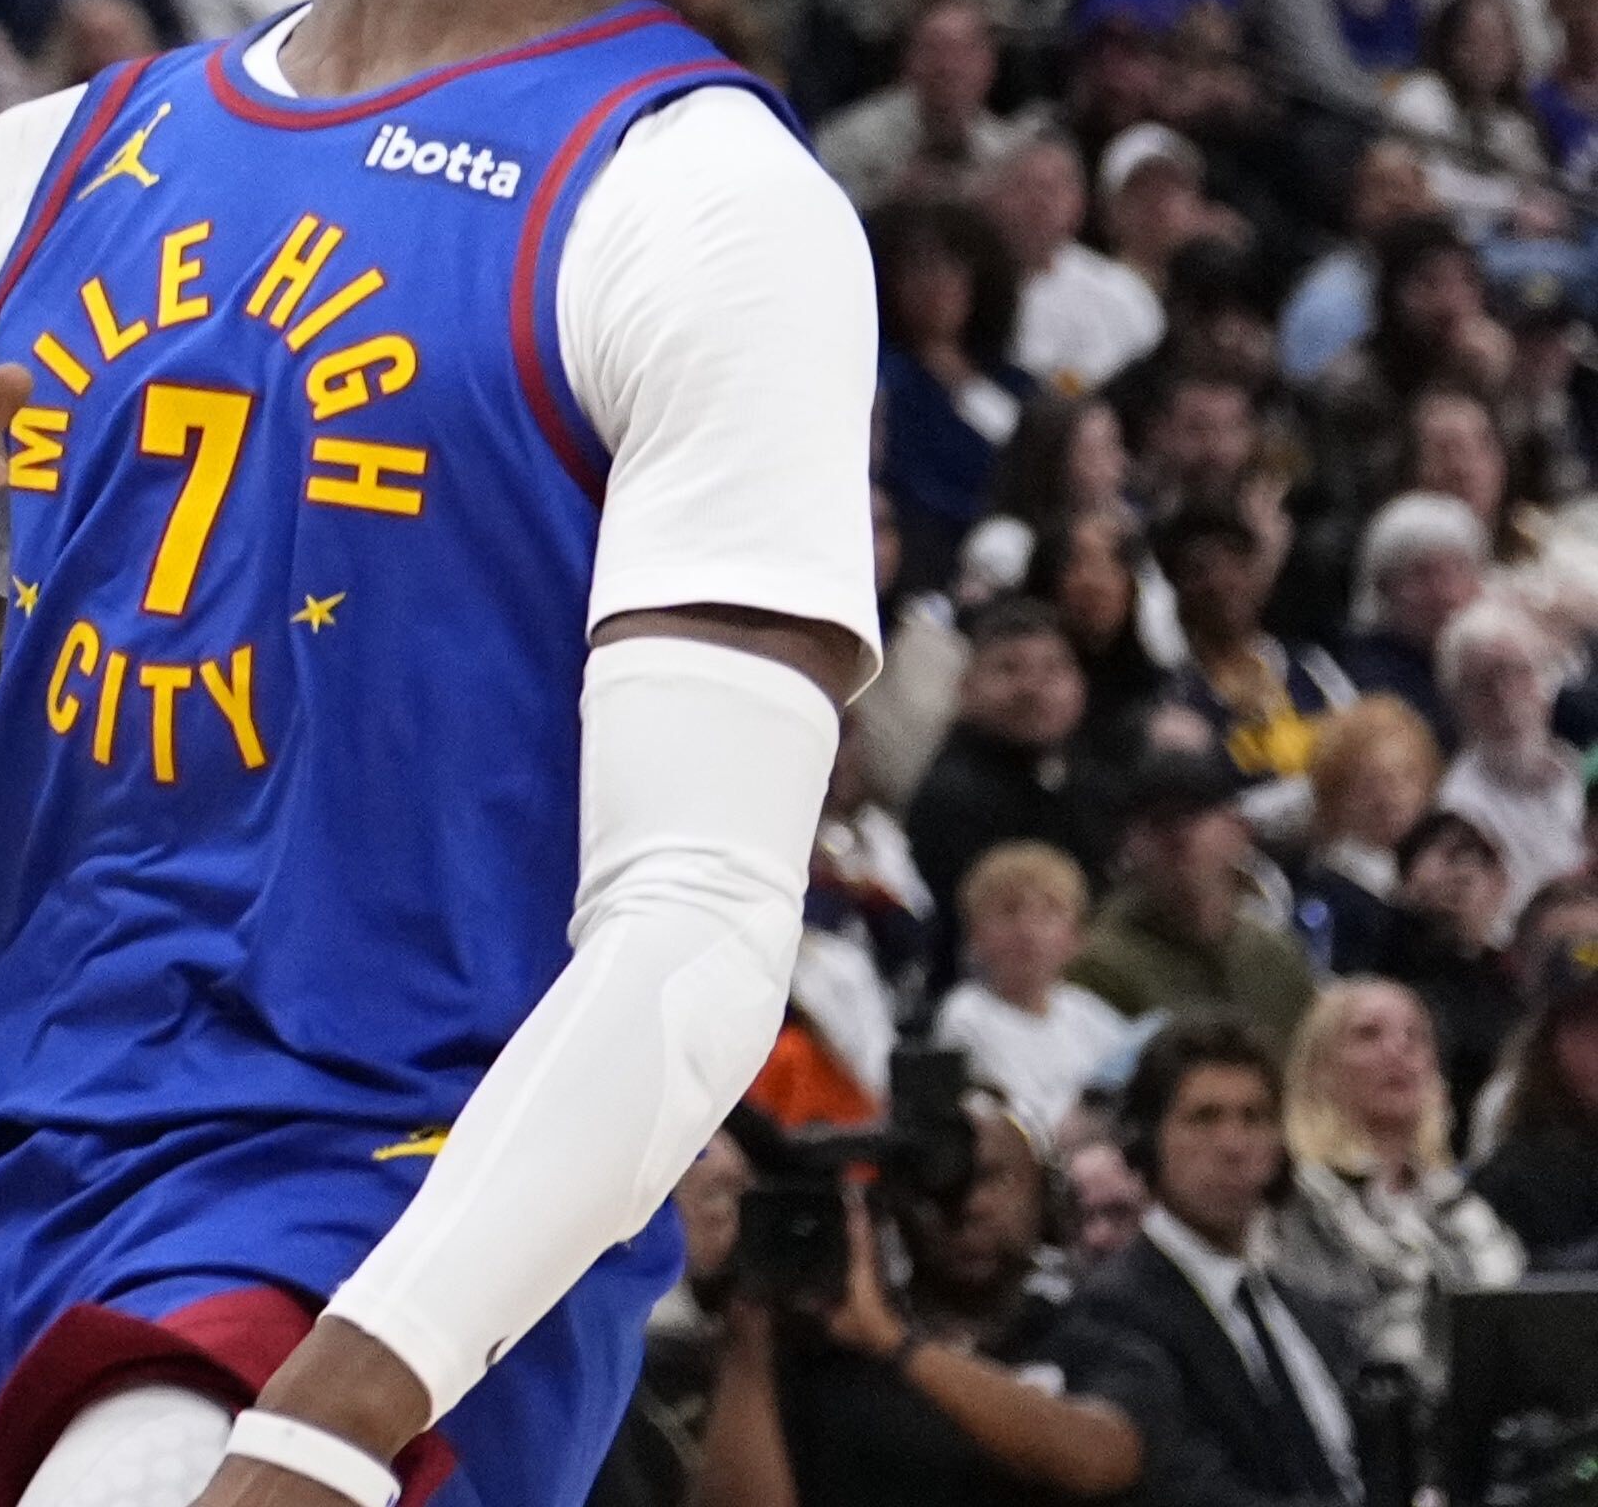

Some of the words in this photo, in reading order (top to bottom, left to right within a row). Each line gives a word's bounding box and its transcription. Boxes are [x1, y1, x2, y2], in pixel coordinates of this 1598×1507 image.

[365, 124, 525, 199] ibotta
[9, 219, 213, 494] MILE
[246, 213, 430, 519] HIGH
[139, 382, 255, 618] 7
[46, 619, 268, 785] CITY
